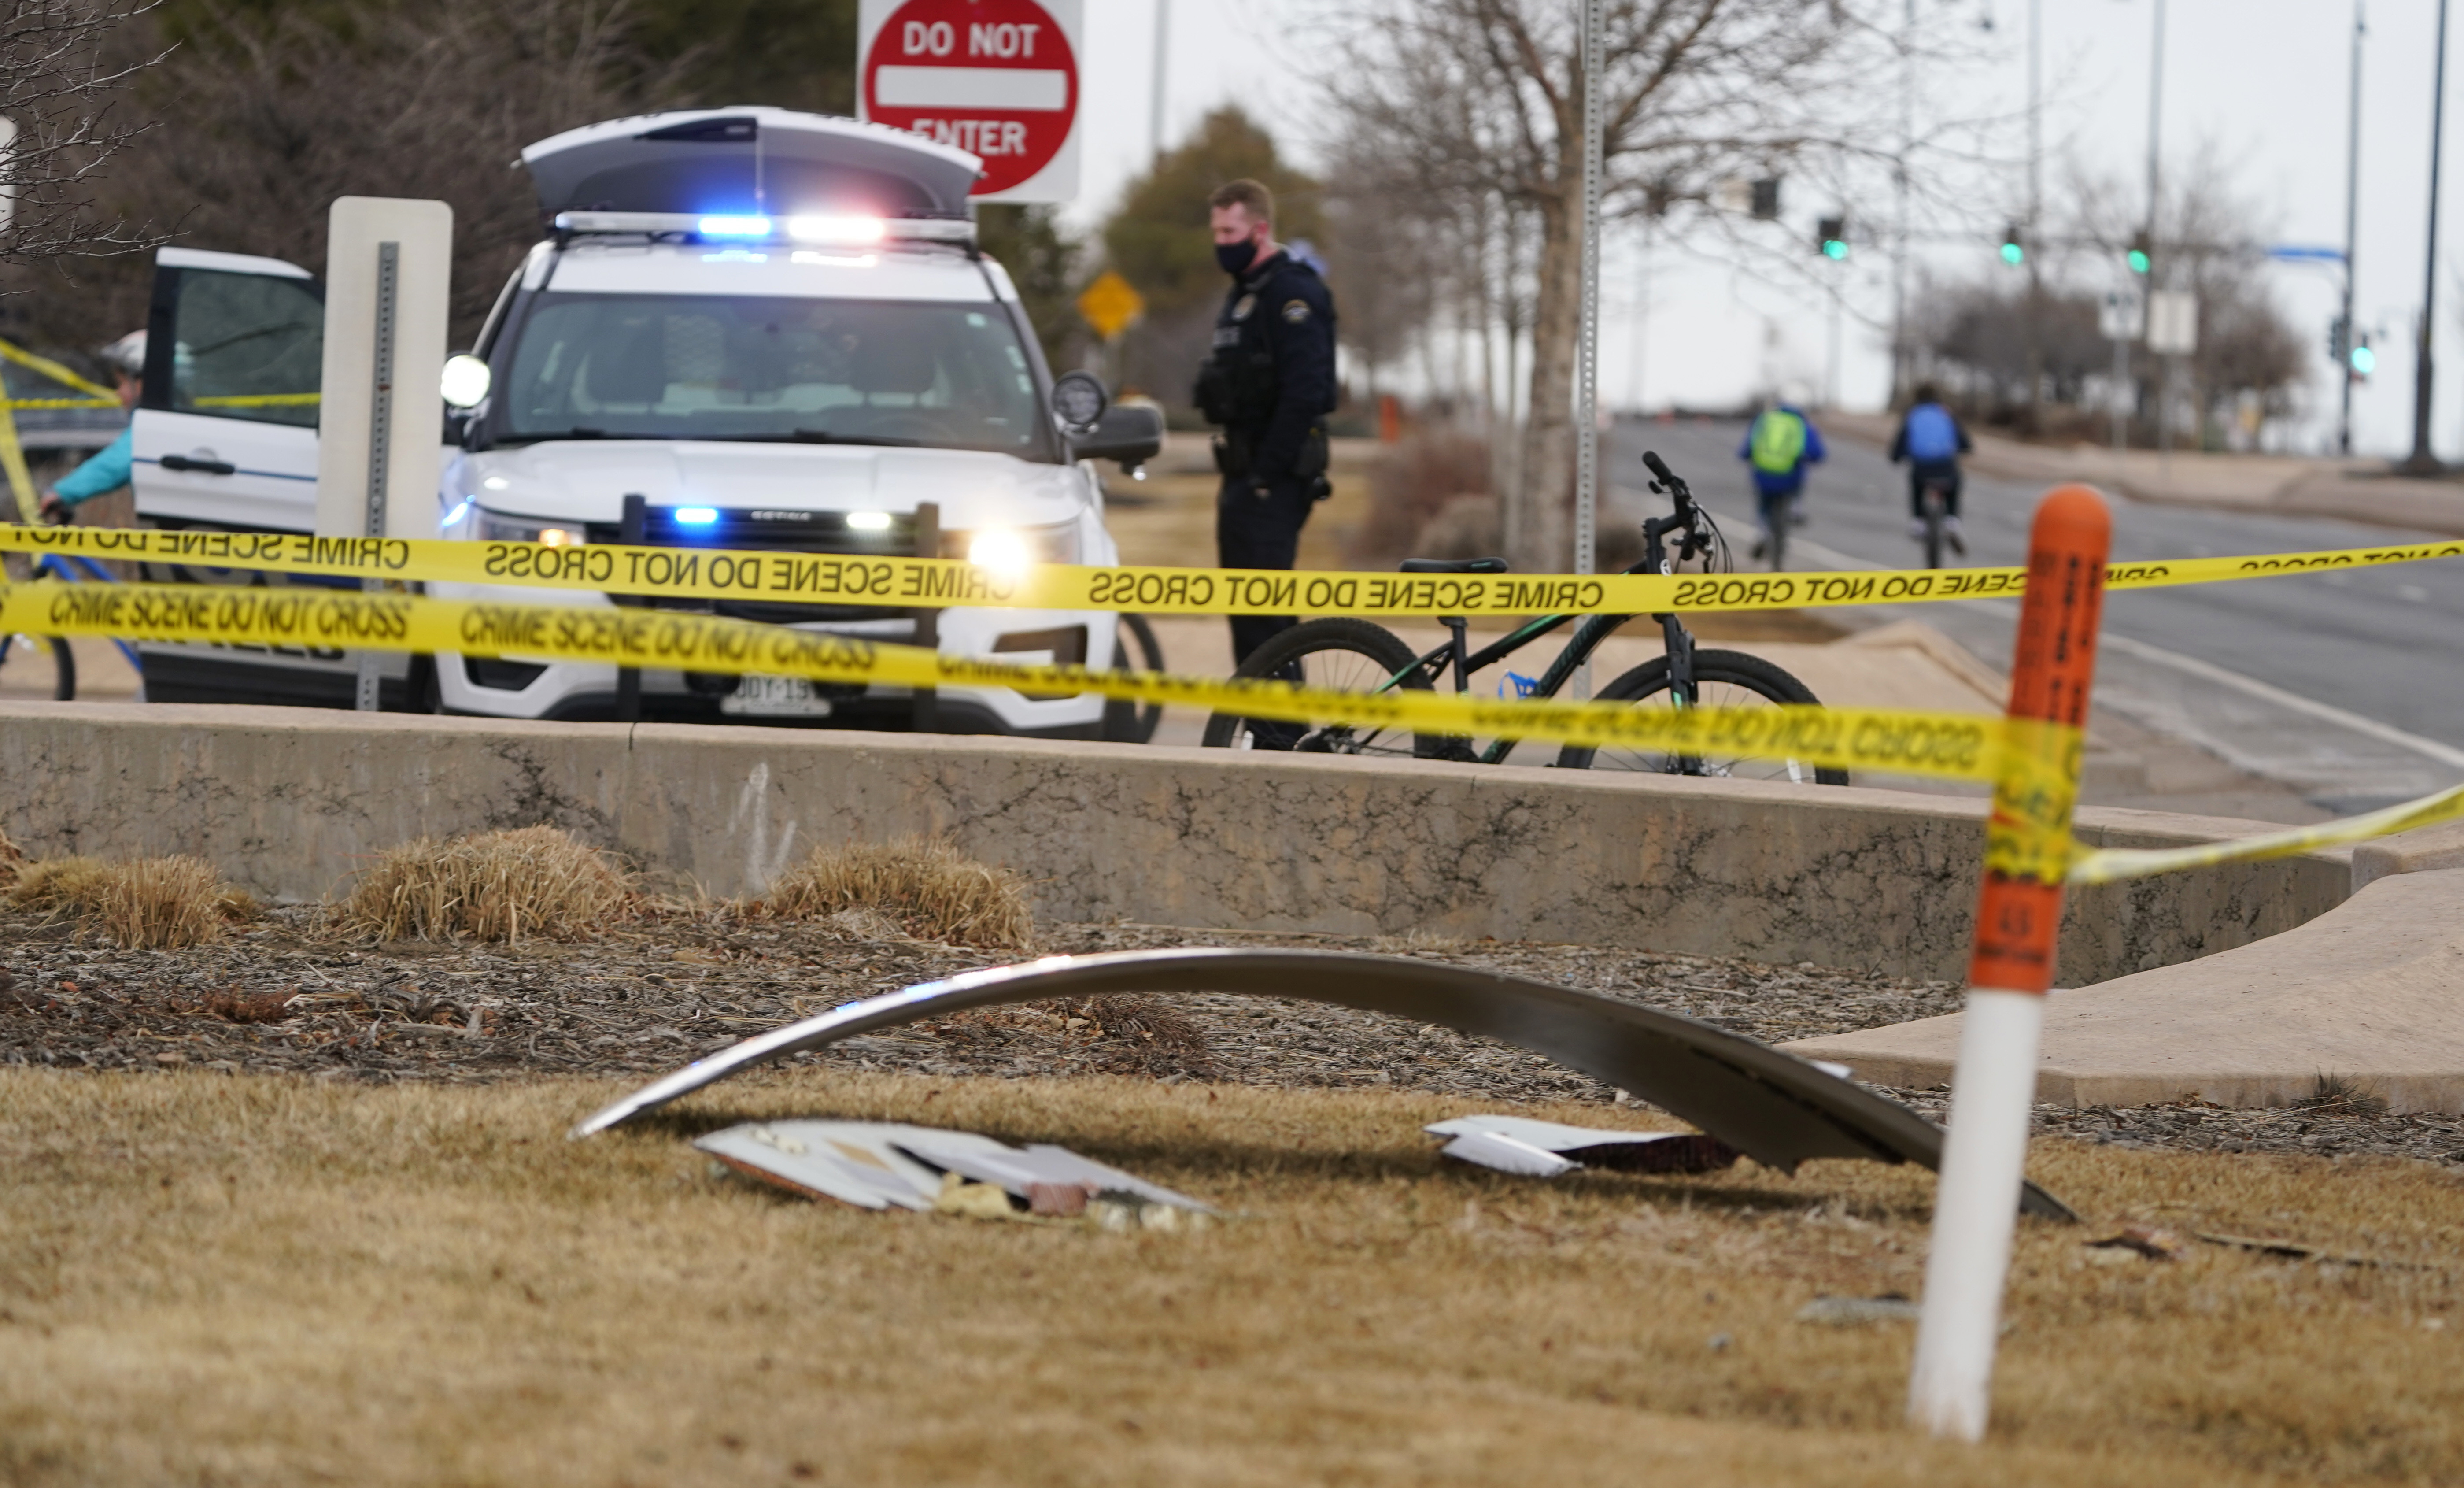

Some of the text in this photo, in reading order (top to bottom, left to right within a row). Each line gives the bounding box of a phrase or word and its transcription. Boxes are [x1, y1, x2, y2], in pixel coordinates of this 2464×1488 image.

[902, 20, 1041, 59] DO NOT
[217, 593, 256, 633] DO
[315, 597, 411, 640] CROSS
